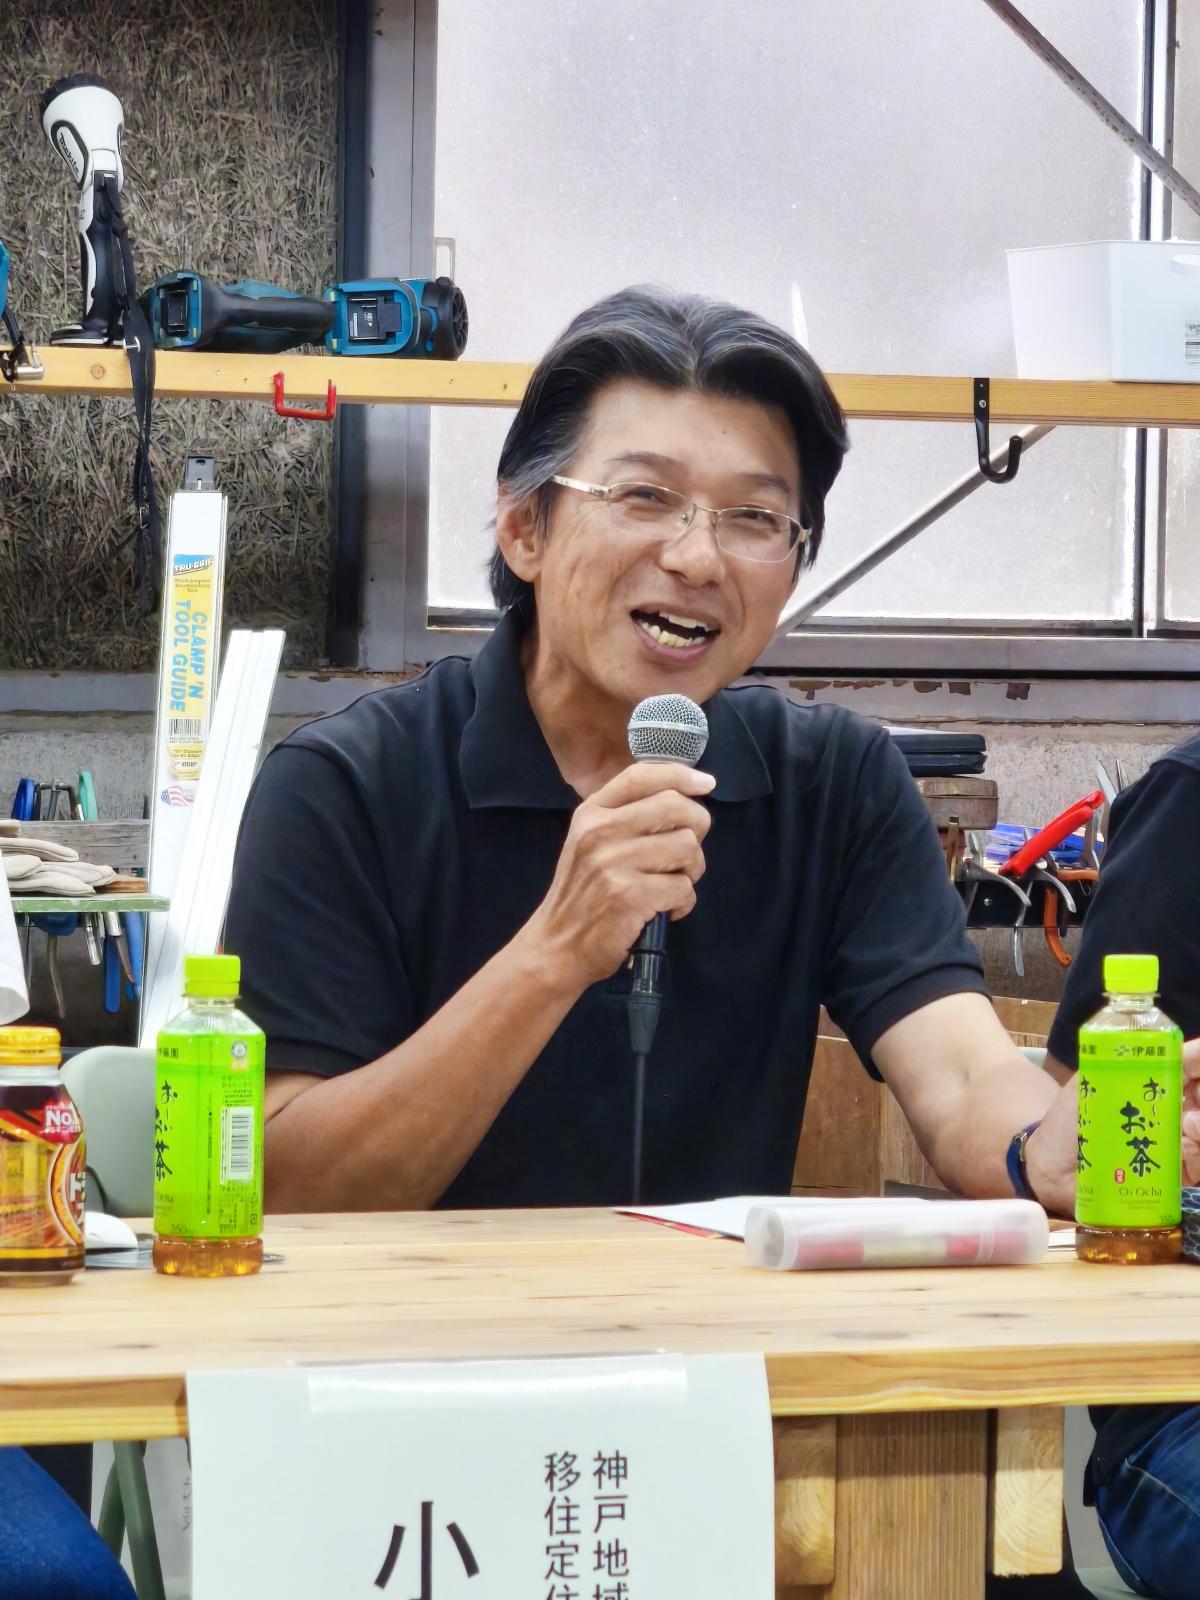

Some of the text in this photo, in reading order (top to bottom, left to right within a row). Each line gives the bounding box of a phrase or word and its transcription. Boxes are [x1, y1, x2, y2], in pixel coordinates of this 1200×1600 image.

[170, 600, 191, 712] TOOL GUIDE
[190, 611, 207, 676] CLAMP
[1120, 1100, 1161, 1178] お茶
[1136, 1186, 1163, 1197] Ocha
[373, 1499, 481, 1600] 小
